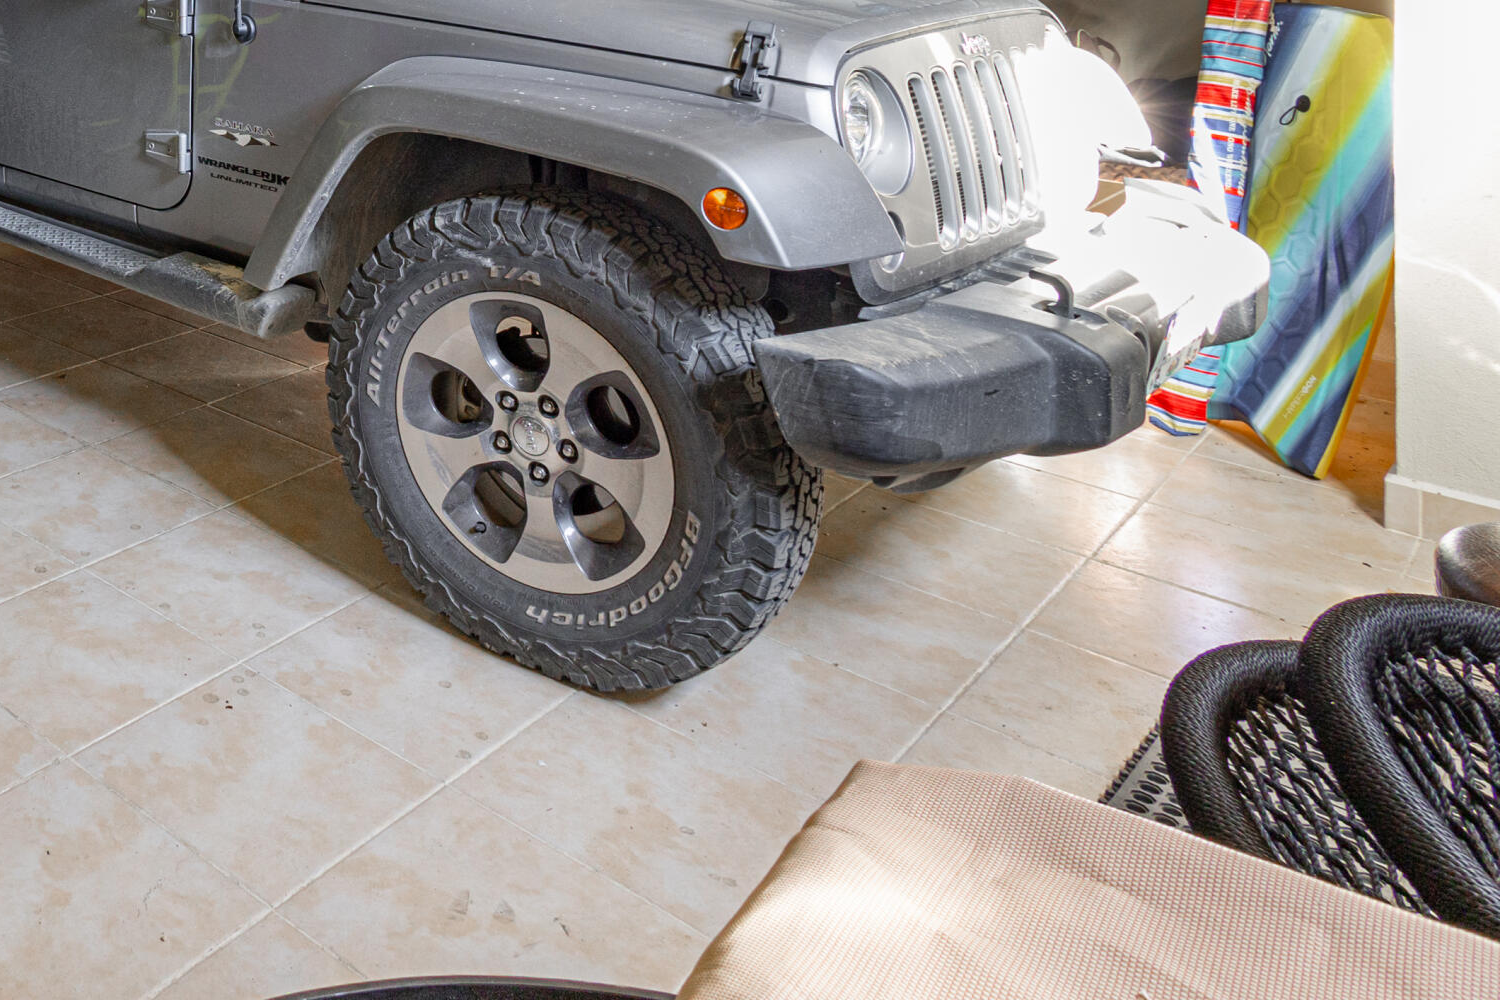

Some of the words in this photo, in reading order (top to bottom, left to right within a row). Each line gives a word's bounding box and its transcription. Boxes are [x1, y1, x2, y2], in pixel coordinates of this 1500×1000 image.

[214, 117, 275, 138] SAHARA
[210, 172, 278, 193] UNLIMITED
[489, 265, 542, 287] T/A
[525, 510, 701, 630] BFGoodrich
